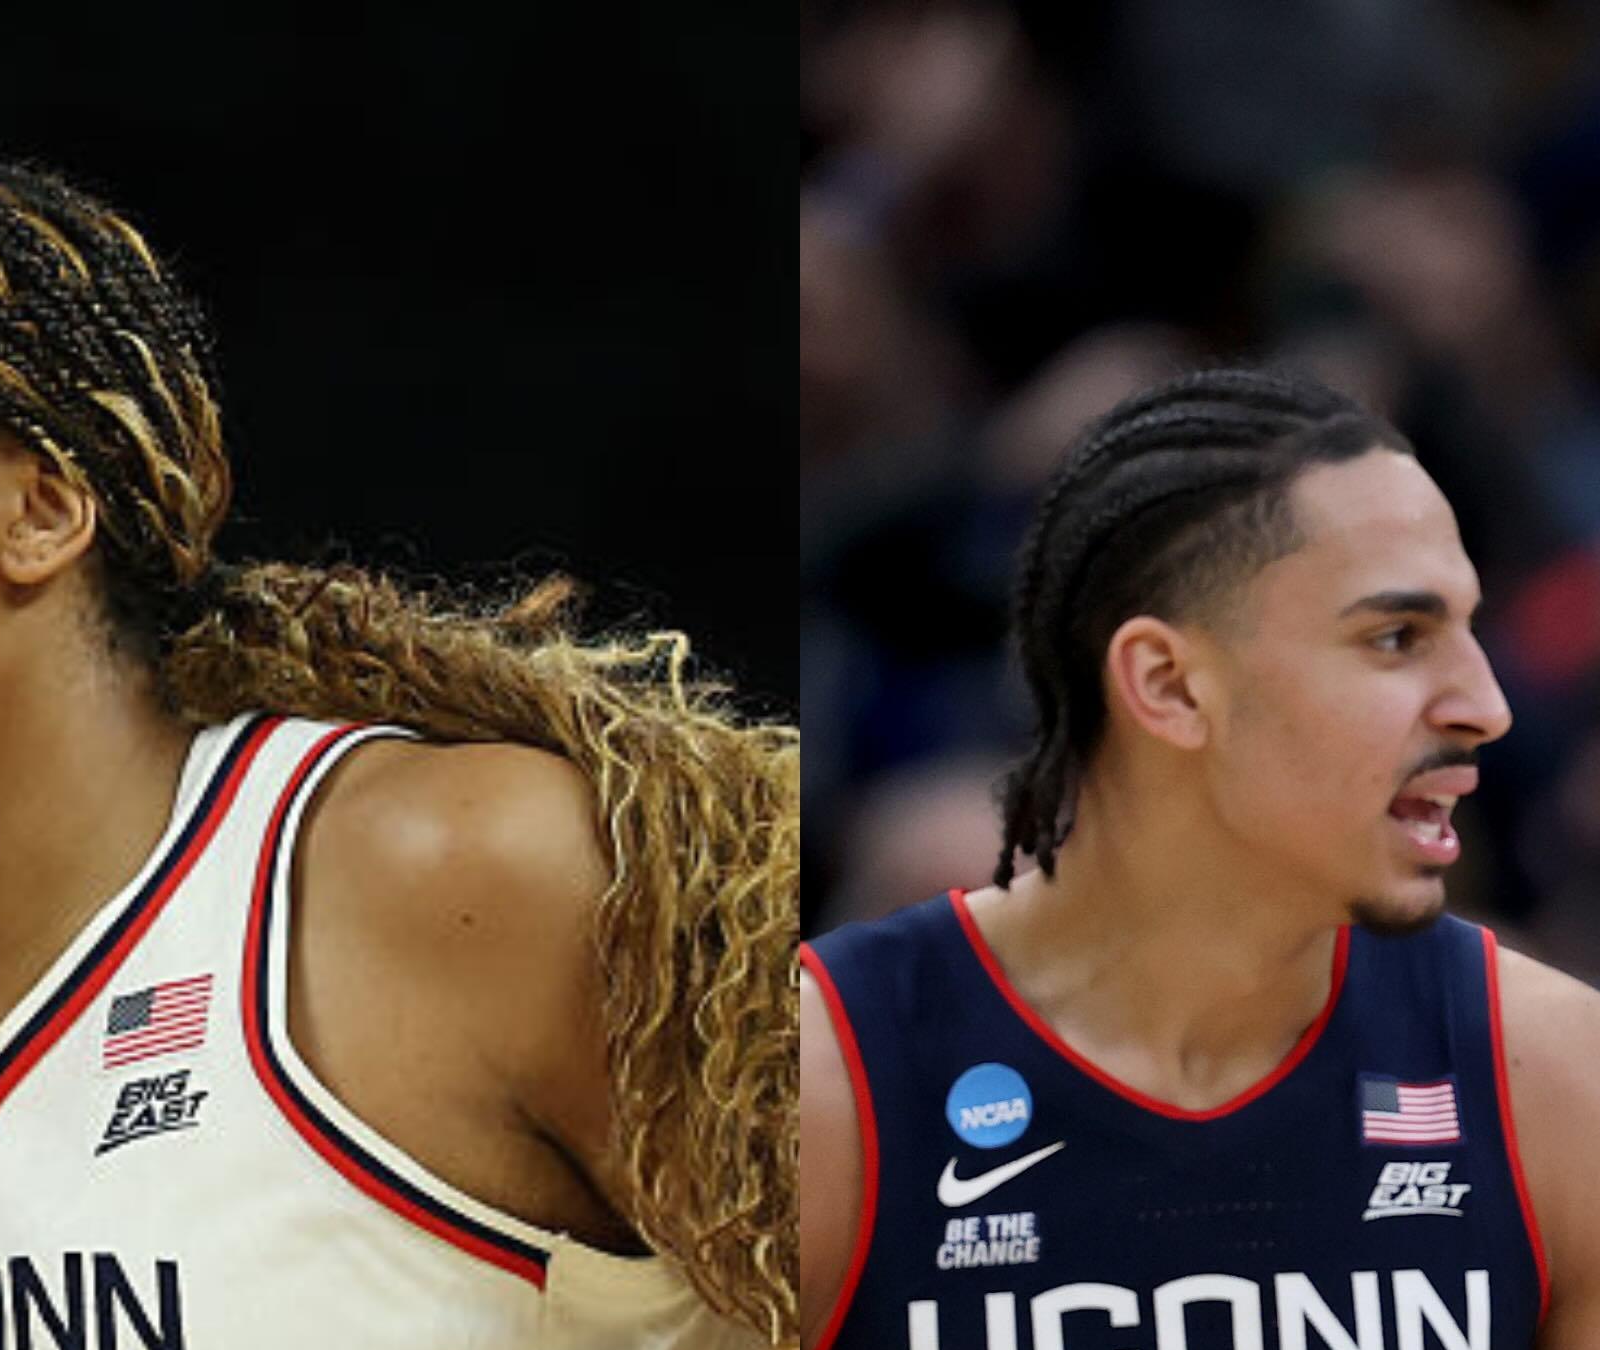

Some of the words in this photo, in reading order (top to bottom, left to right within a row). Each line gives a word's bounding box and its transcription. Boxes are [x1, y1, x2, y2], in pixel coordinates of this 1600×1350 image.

[117, 1069, 190, 1109] BIG
[103, 1090, 208, 1139] EAST
[960, 1098, 1027, 1129] NCAA
[1378, 1162, 1451, 1186] BIG
[1368, 1183, 1471, 1207] EAST
[946, 1217, 980, 1241] BE
[987, 1211, 1035, 1239] THE
[937, 1237, 1040, 1270] CHANGE
